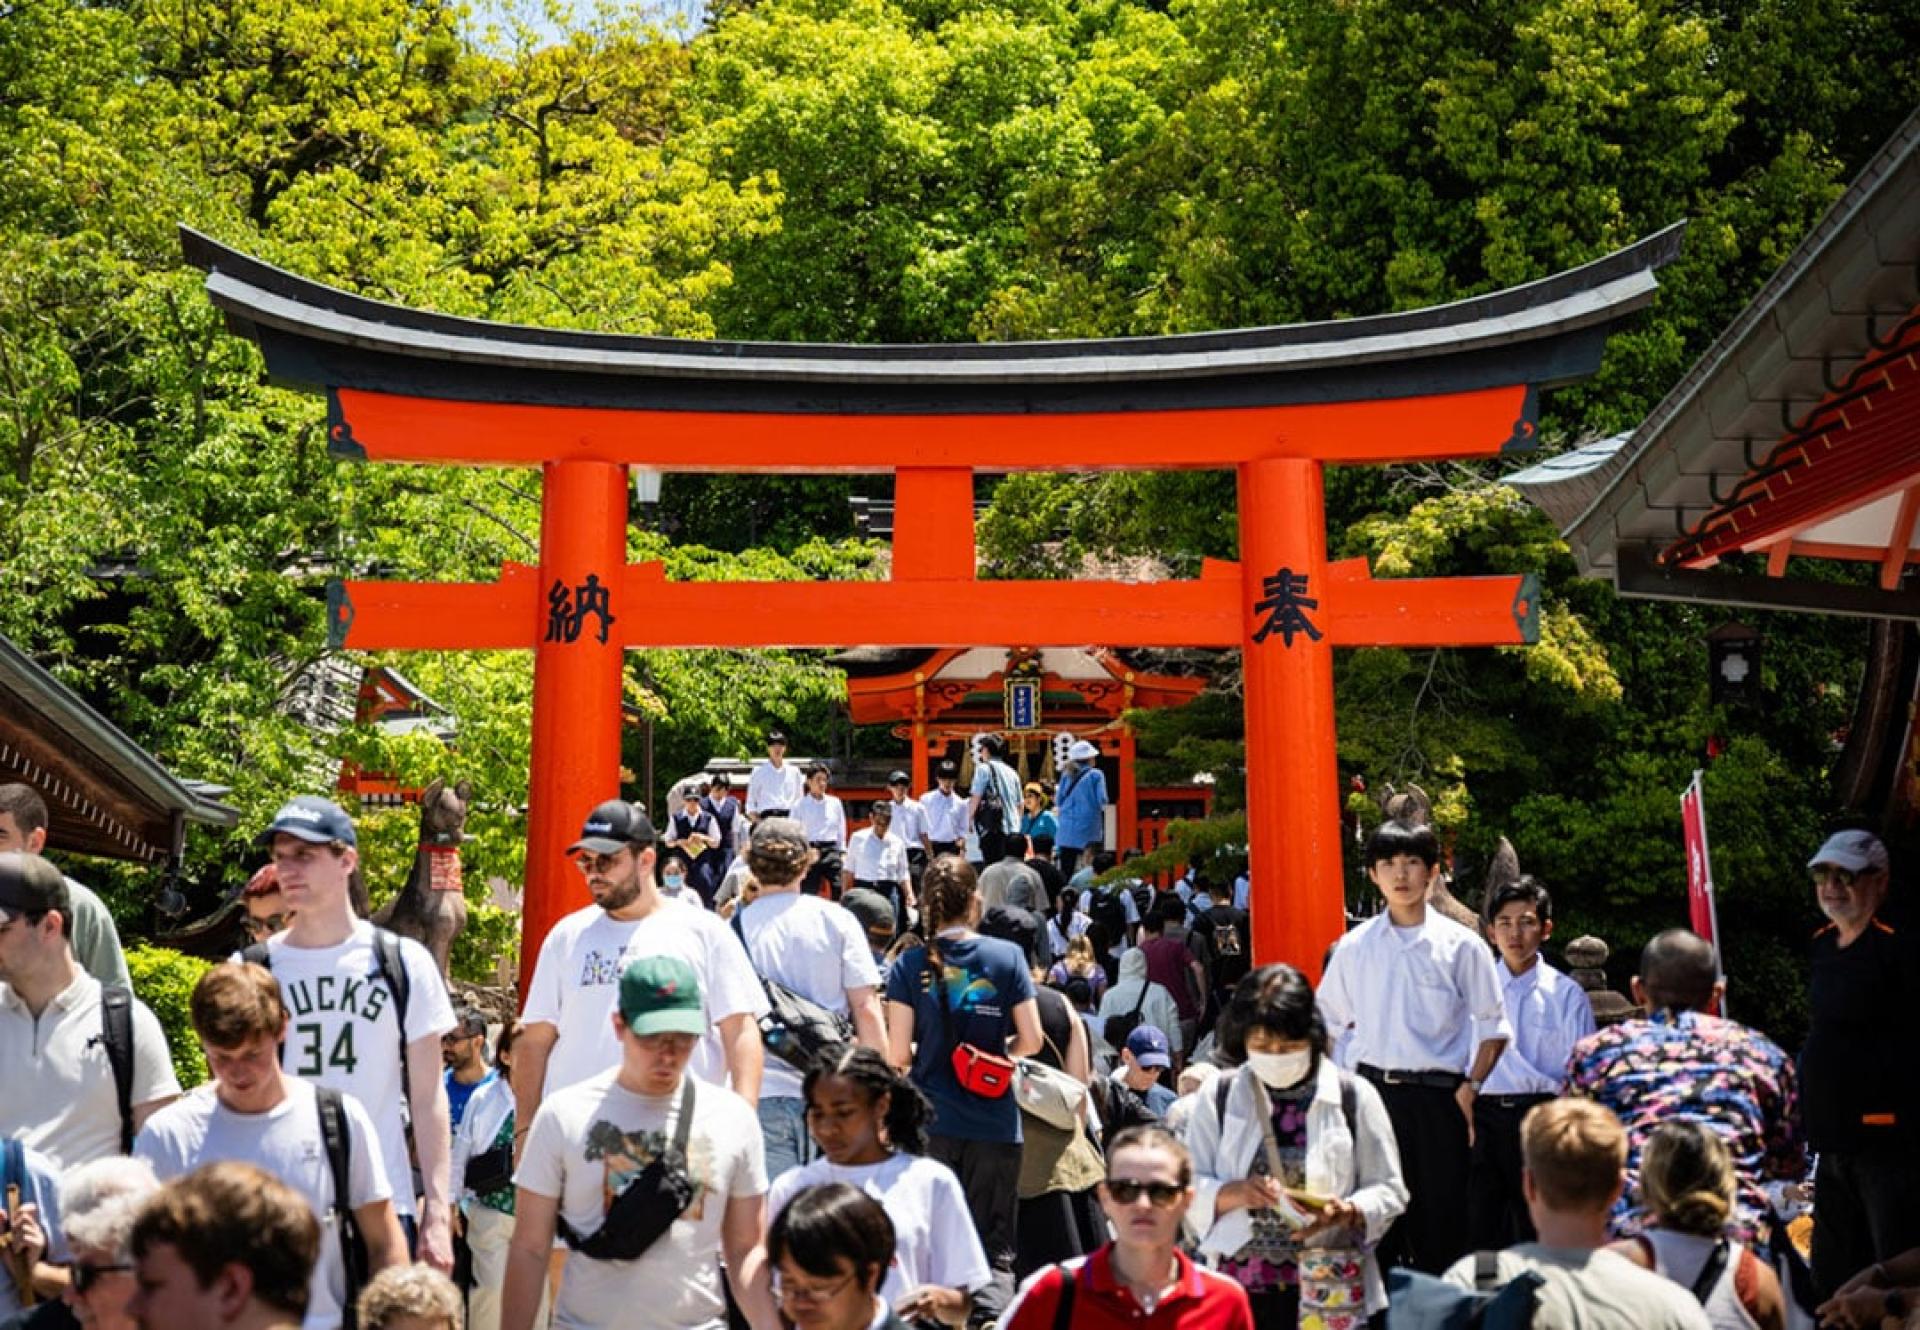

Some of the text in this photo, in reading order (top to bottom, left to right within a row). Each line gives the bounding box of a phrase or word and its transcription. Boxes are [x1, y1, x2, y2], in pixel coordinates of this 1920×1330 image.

[544, 574, 616, 645] 納
[1252, 568, 1324, 648] 奉
[288, 976, 388, 1022] UCKS
[296, 1022, 358, 1076] 34
